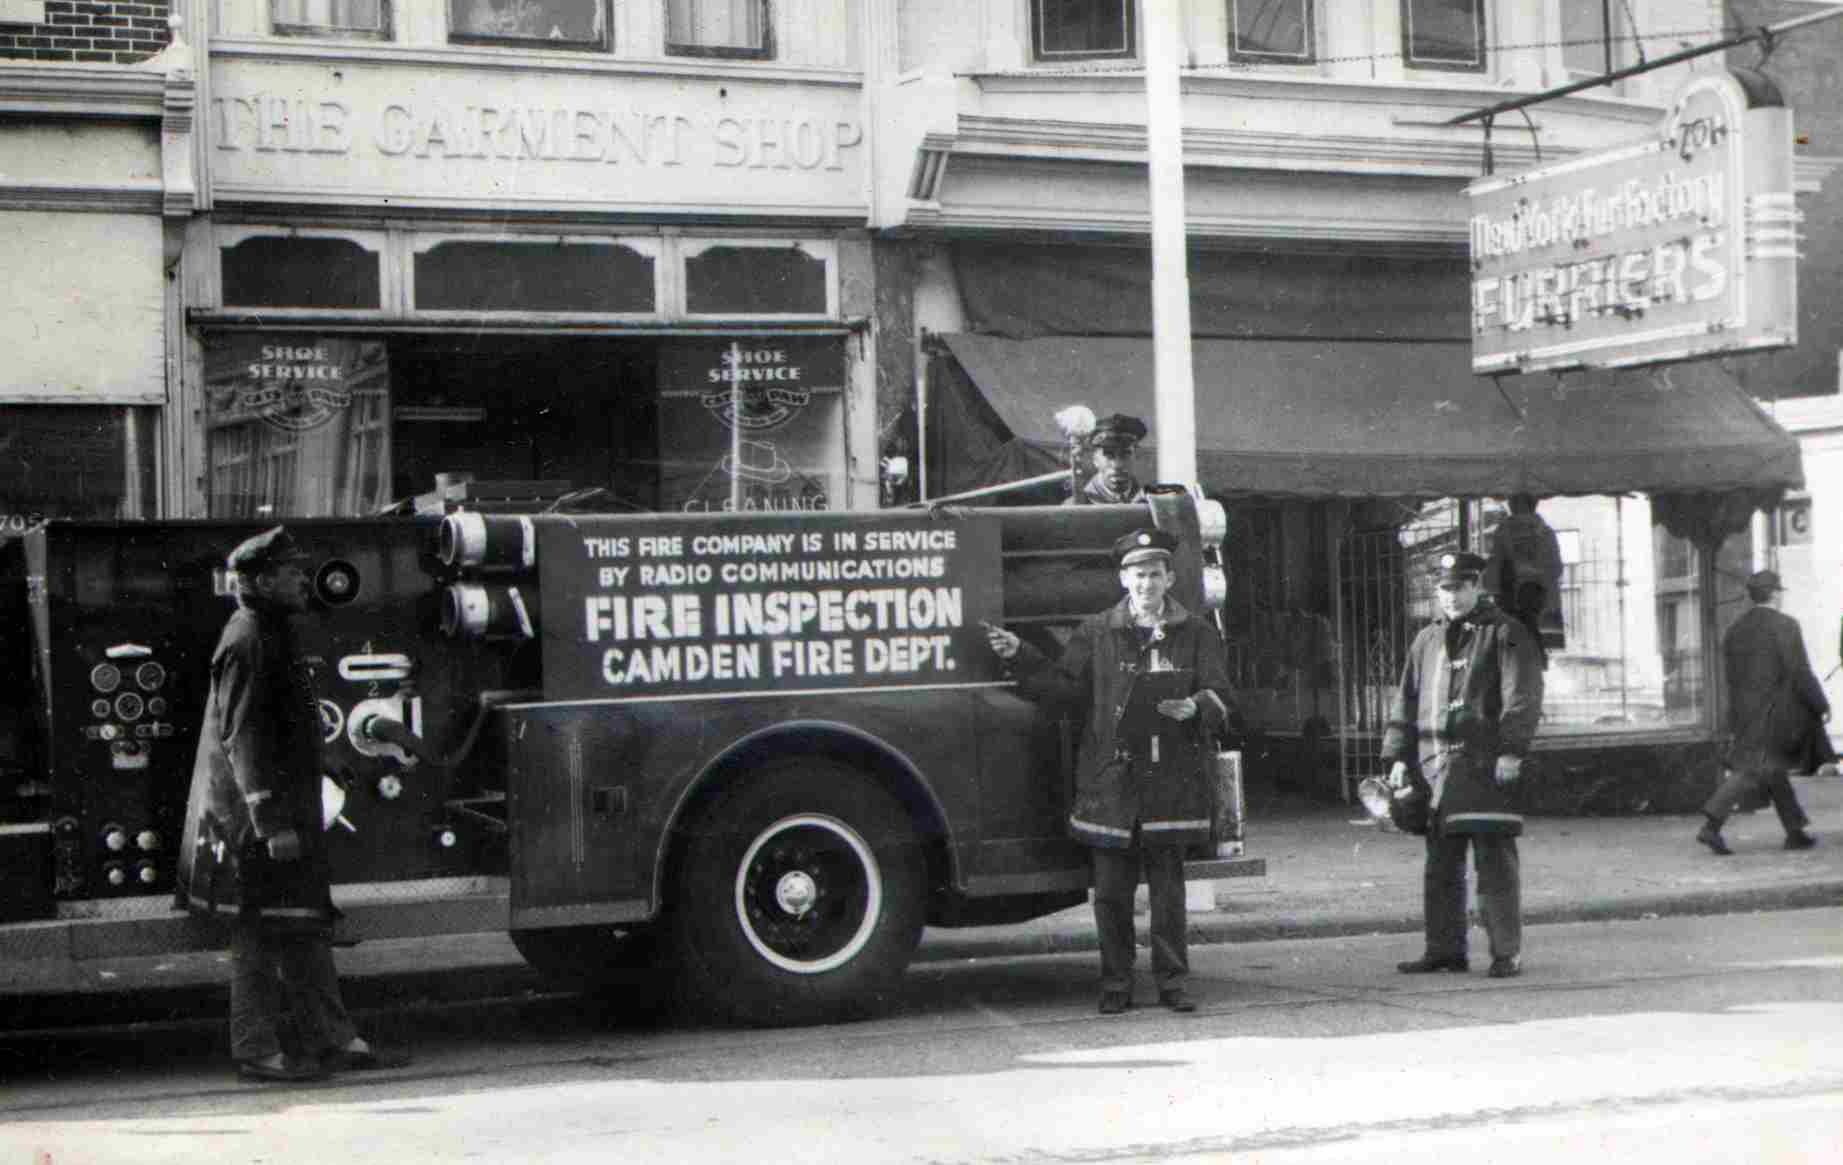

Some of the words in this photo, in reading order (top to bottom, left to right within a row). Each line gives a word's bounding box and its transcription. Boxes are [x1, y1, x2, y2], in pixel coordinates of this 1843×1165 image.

[213, 96, 350, 155] THE
[376, 103, 694, 168] GARMENT
[711, 115, 864, 172] SHOP
[1472, 231, 1728, 332] FURRIERS
[261, 345, 328, 361] SHOE
[721, 350, 786, 364] SHOE
[248, 364, 343, 380] SERVICE
[707, 367, 801, 382] SERVICE
[584, 538, 631, 558] THIS
[638, 536, 683, 557] FIRE
[692, 533, 796, 556] COMPANY
[802, 532, 823, 553] IS
[834, 531, 857, 551] IN
[864, 530, 957, 551] SERVICE
[600, 567, 628, 587] BY
[640, 563, 712, 586] RADIO
[721, 557, 945, 584] COMMUNICATIONS
[585, 594, 702, 641] FIRE
[715, 587, 963, 637] INSPECTION
[602, 643, 761, 685] CAMDEN
[771, 639, 854, 678] FIRE
[864, 635, 957, 674] DEPT.
